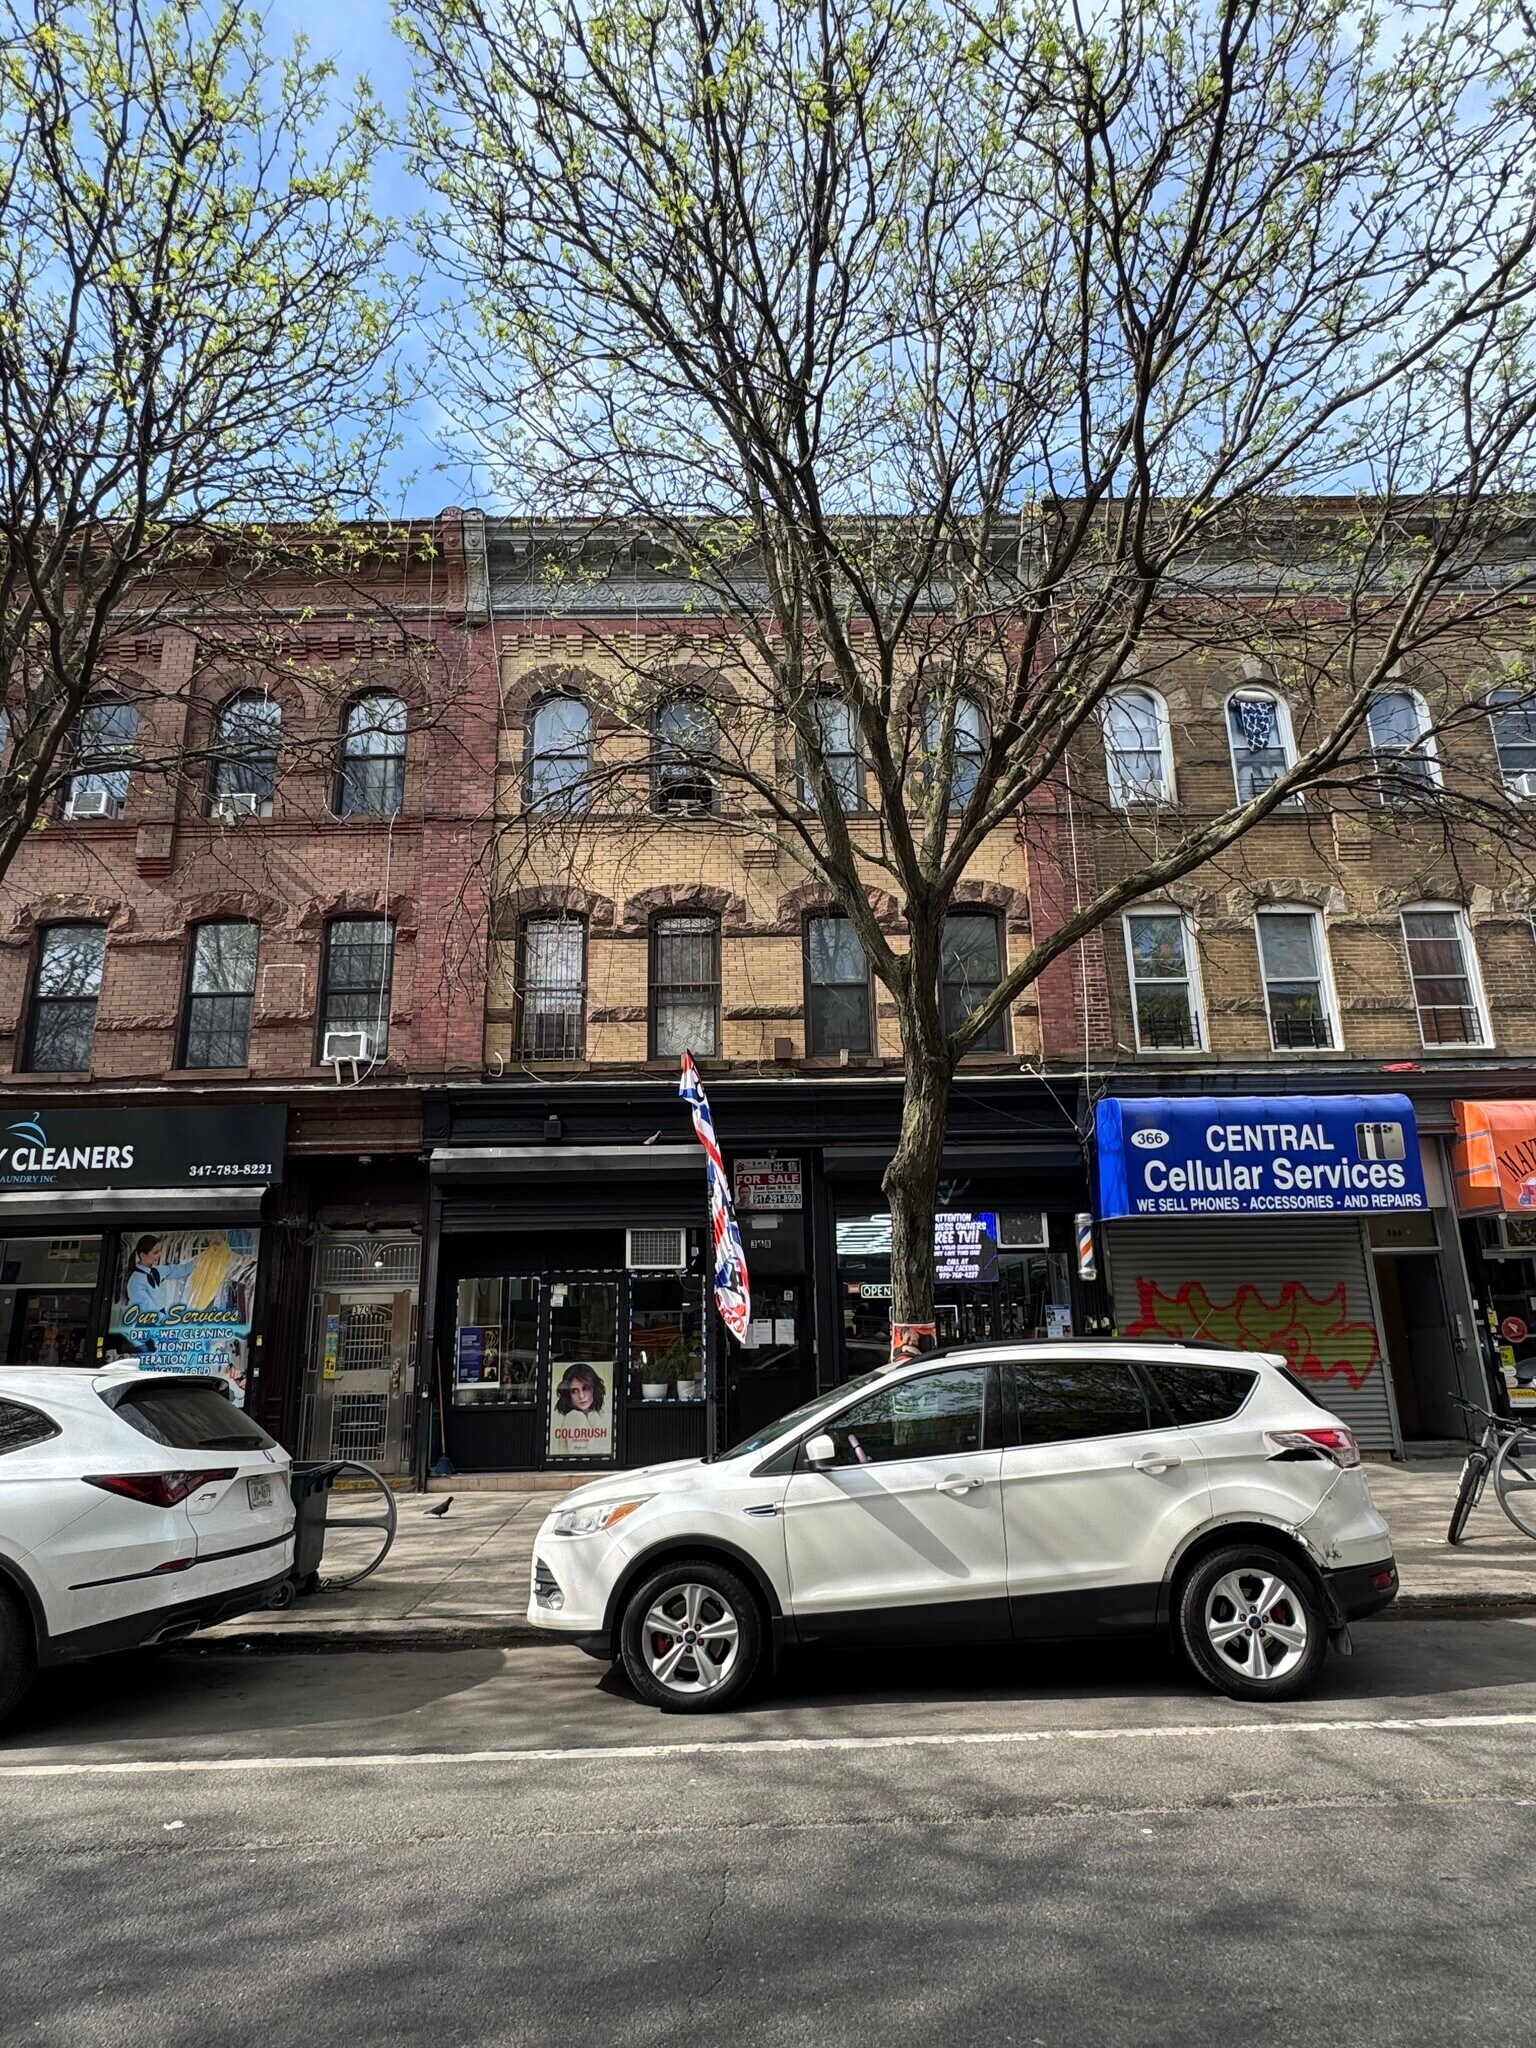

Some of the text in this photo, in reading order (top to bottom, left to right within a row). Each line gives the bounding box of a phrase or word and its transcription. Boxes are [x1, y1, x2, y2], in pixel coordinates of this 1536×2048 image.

[1137, 1132, 1163, 1145] 366
[1206, 1124, 1334, 1152] CENTRAL
[12, 1145, 134, 1171] CLEANERS
[189, 1163, 273, 1176] 347-783-8221
[1144, 1158, 1405, 1193] Cellular Services
[0, 1175, 39, 1183] AUNDRY
[736, 1173, 799, 1185] FOR SALE
[1136, 1199, 1156, 1211] WE
[1159, 1199, 1188, 1212] SELL
[1191, 1197, 1240, 1210] PHONES
[1250, 1195, 1332, 1210] ACCESSORIES
[1344, 1195, 1370, 1208] AND
[1373, 1194, 1422, 1208] REPAIRS
[935, 1221, 987, 1231] NESS OWNERS
[935, 1231, 955, 1243] REE
[863, 1286, 891, 1296] OPEN
[124, 1306, 239, 1325] Our Services
[130, 1331, 148, 1339] DRY
[182, 1329, 233, 1338] CLEANING
[158, 1342, 202, 1351] IRONING
[138, 1355, 186, 1365] TERATION
[197, 1354, 229, 1363] REPAIR
[554, 1428, 607, 1439] COLORUSH
